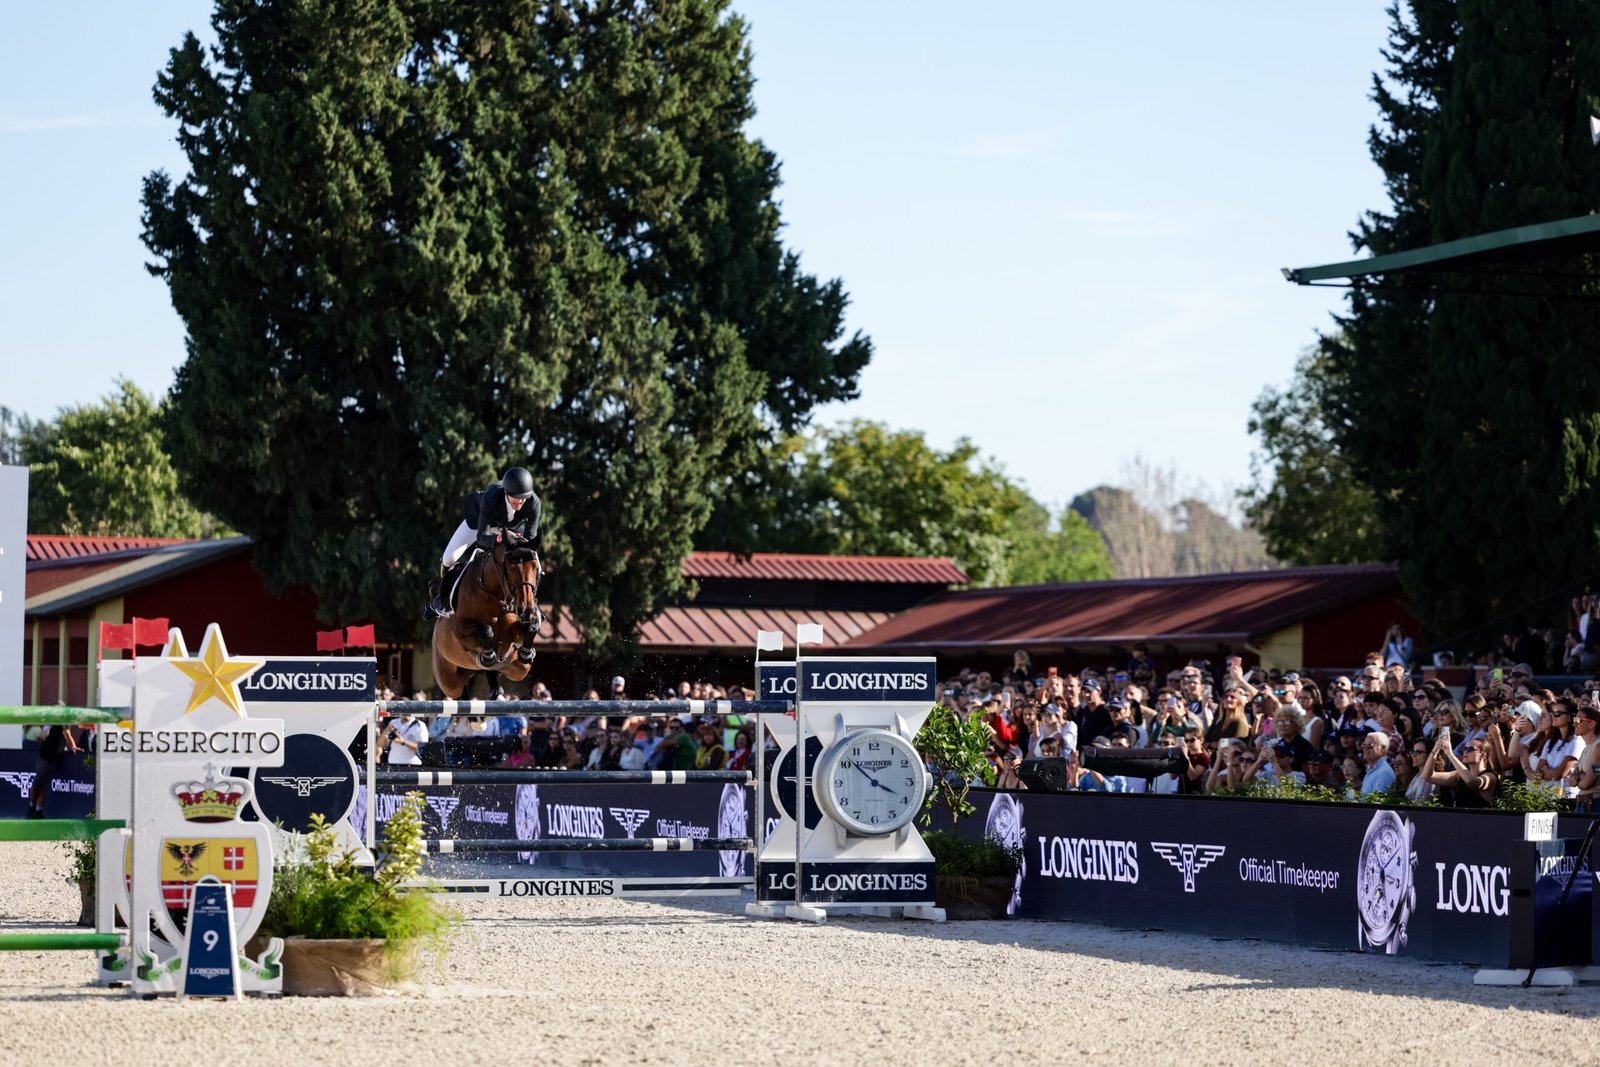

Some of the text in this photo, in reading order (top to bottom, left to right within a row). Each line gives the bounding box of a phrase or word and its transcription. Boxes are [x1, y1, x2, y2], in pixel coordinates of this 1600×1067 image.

[245, 672, 368, 691] LONGINES
[810, 672, 929, 690] LONGINES
[137, 731, 281, 754] ESERCITO
[868, 742, 880, 751] 12
[852, 747, 860, 756] 11
[891, 747, 895, 756] 1
[840, 761, 851, 769] 10
[900, 760, 909, 768] 2
[834, 779, 843, 788] 9
[905, 778, 914, 787] 3
[840, 798, 849, 806] 8
[899, 796, 908, 805] 4
[853, 811, 861, 820] 7
[888, 810, 897, 819] 5
[546, 804, 604, 839] LONGINES
[870, 816, 879, 824] 6
[1038, 836, 1340, 893] LONGINES Official Timekeeper
[810, 873, 928, 891] LONGINES
[498, 880, 615, 897] LONGINES
[203, 929, 219, 952] 9
[189, 967, 230, 975] LONGINES
